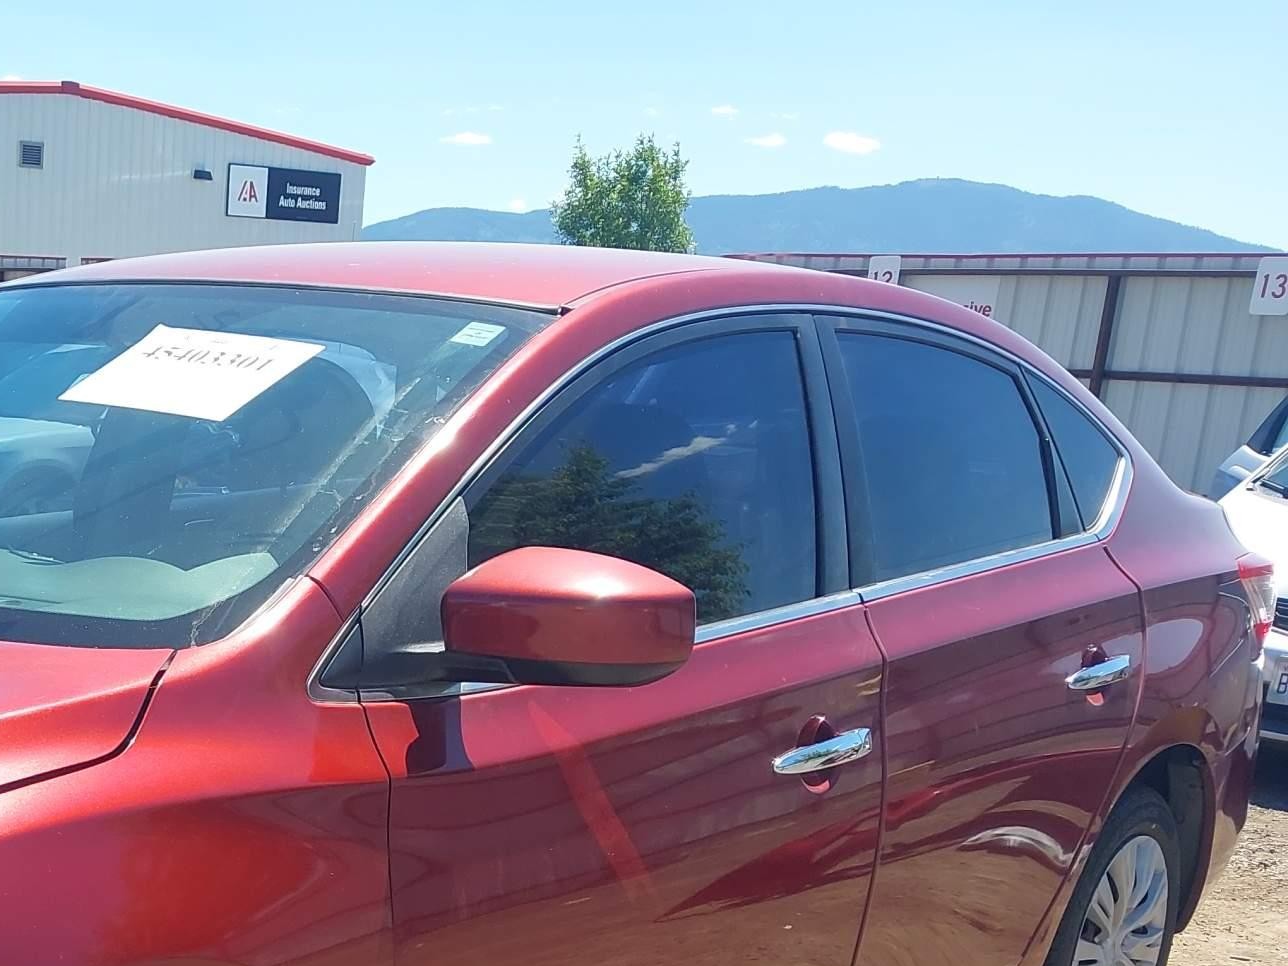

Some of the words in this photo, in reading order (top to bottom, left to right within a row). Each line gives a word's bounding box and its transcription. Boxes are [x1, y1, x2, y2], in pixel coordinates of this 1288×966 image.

[286, 182, 320, 196] Insurance
[278, 195, 295, 208] Auto
[296, 196, 326, 210] Auctions
[1261, 273, 1288, 299] 13
[142, 346, 273, 371] 45403301
